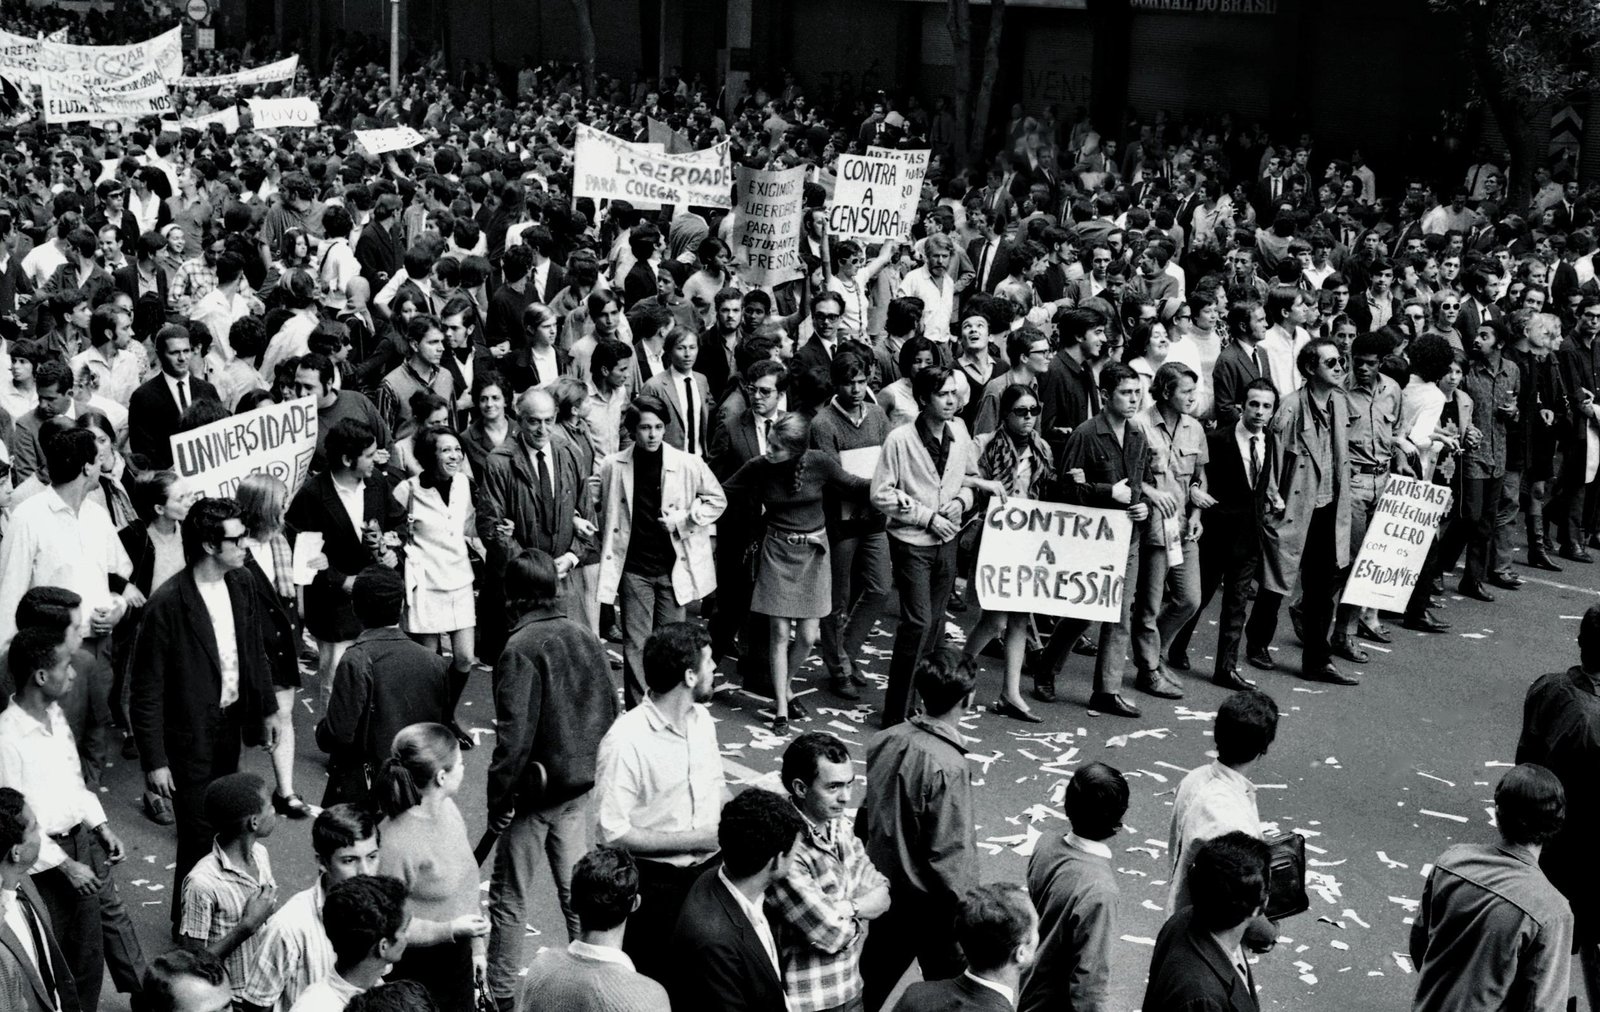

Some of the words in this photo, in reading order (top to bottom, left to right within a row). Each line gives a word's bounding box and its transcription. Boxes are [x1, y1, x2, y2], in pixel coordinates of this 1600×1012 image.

[616, 156, 730, 187] LIBERDADE
[844, 159, 897, 187] CONTRA
[585, 174, 618, 193] PARA
[625, 178, 682, 203] COLEGAS
[861, 187, 874, 206] A
[746, 220, 776, 235] PARA
[829, 205, 900, 237] CENSURA
[748, 249, 796, 270] PRESOS
[176, 404, 316, 477] UNIVERSIDADE
[1384, 479, 1447, 505] ARTISTAS
[987, 505, 1116, 541] CONTRA
[1384, 522, 1425, 545] CLERO
[1035, 540, 1056, 565] A
[1366, 541, 1388, 552] COM
[980, 564, 1125, 608] REPRESSÃO
[1354, 559, 1420, 587] ESTUDANTES
